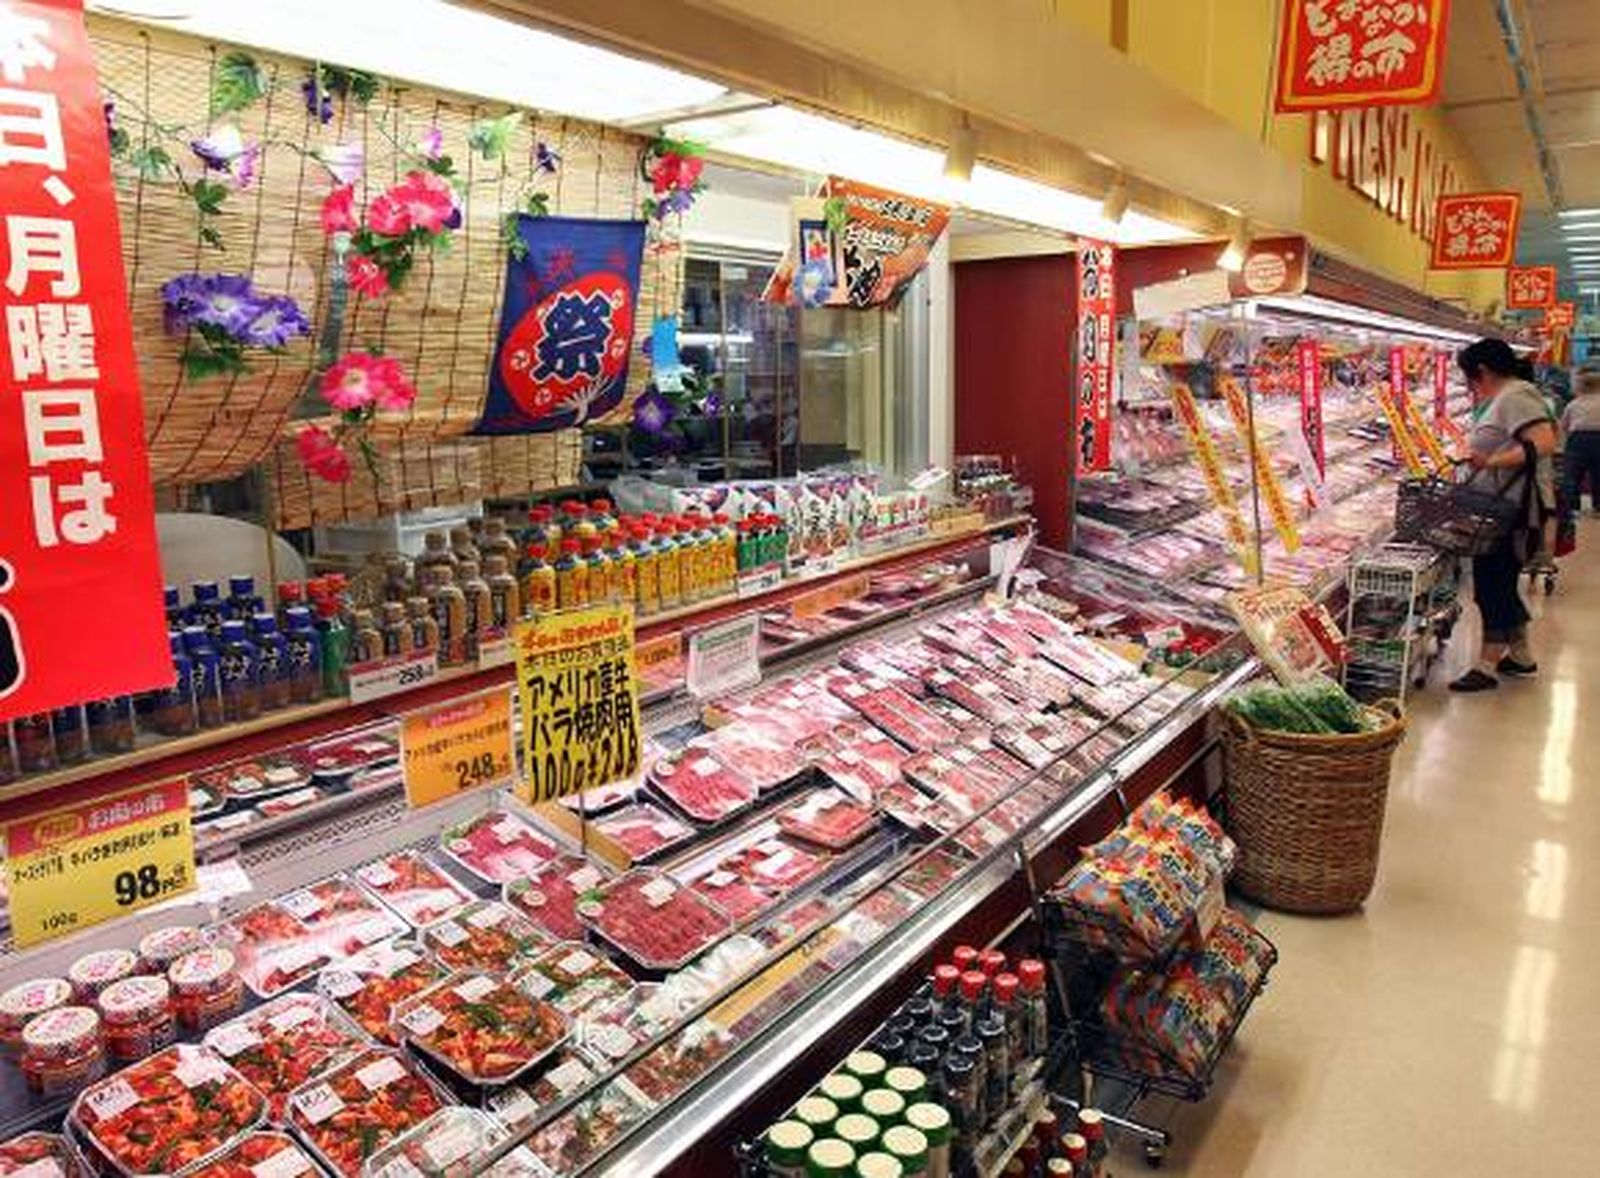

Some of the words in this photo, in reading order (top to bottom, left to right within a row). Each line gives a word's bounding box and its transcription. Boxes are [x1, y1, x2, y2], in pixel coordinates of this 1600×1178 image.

[0, 2, 117, 548] 本日、月曜日は
[529, 289, 615, 385] 祭
[456, 752, 496, 790] 248
[115, 865, 162, 906] 98
